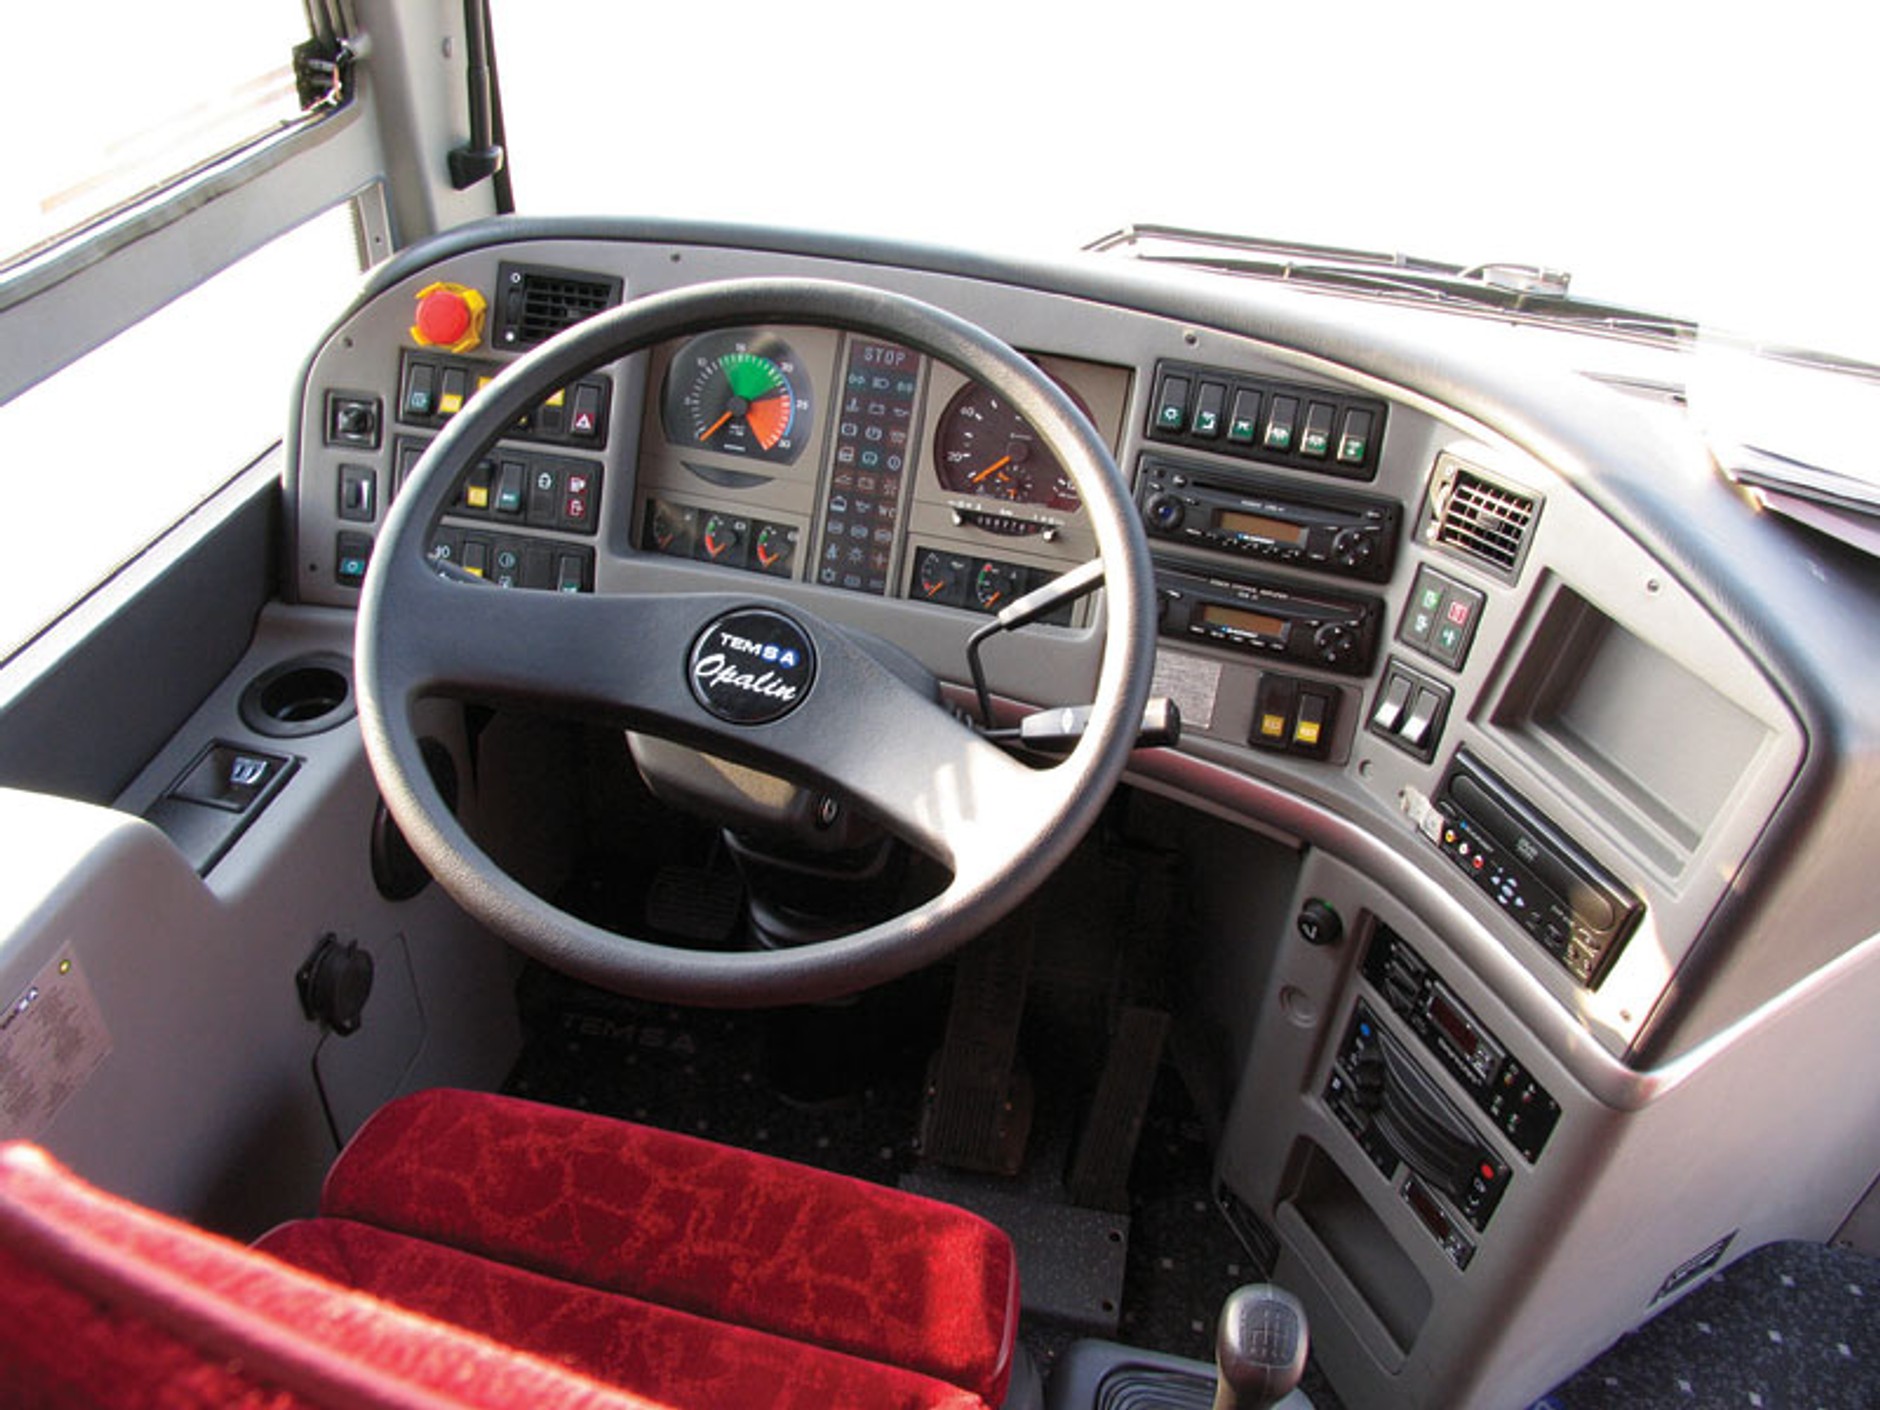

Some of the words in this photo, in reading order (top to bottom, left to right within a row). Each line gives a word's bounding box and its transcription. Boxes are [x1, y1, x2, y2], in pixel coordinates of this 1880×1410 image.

[864, 347, 906, 366] STOP
[721, 632, 795, 667] TEMSA
[696, 653, 796, 701] Opalin
